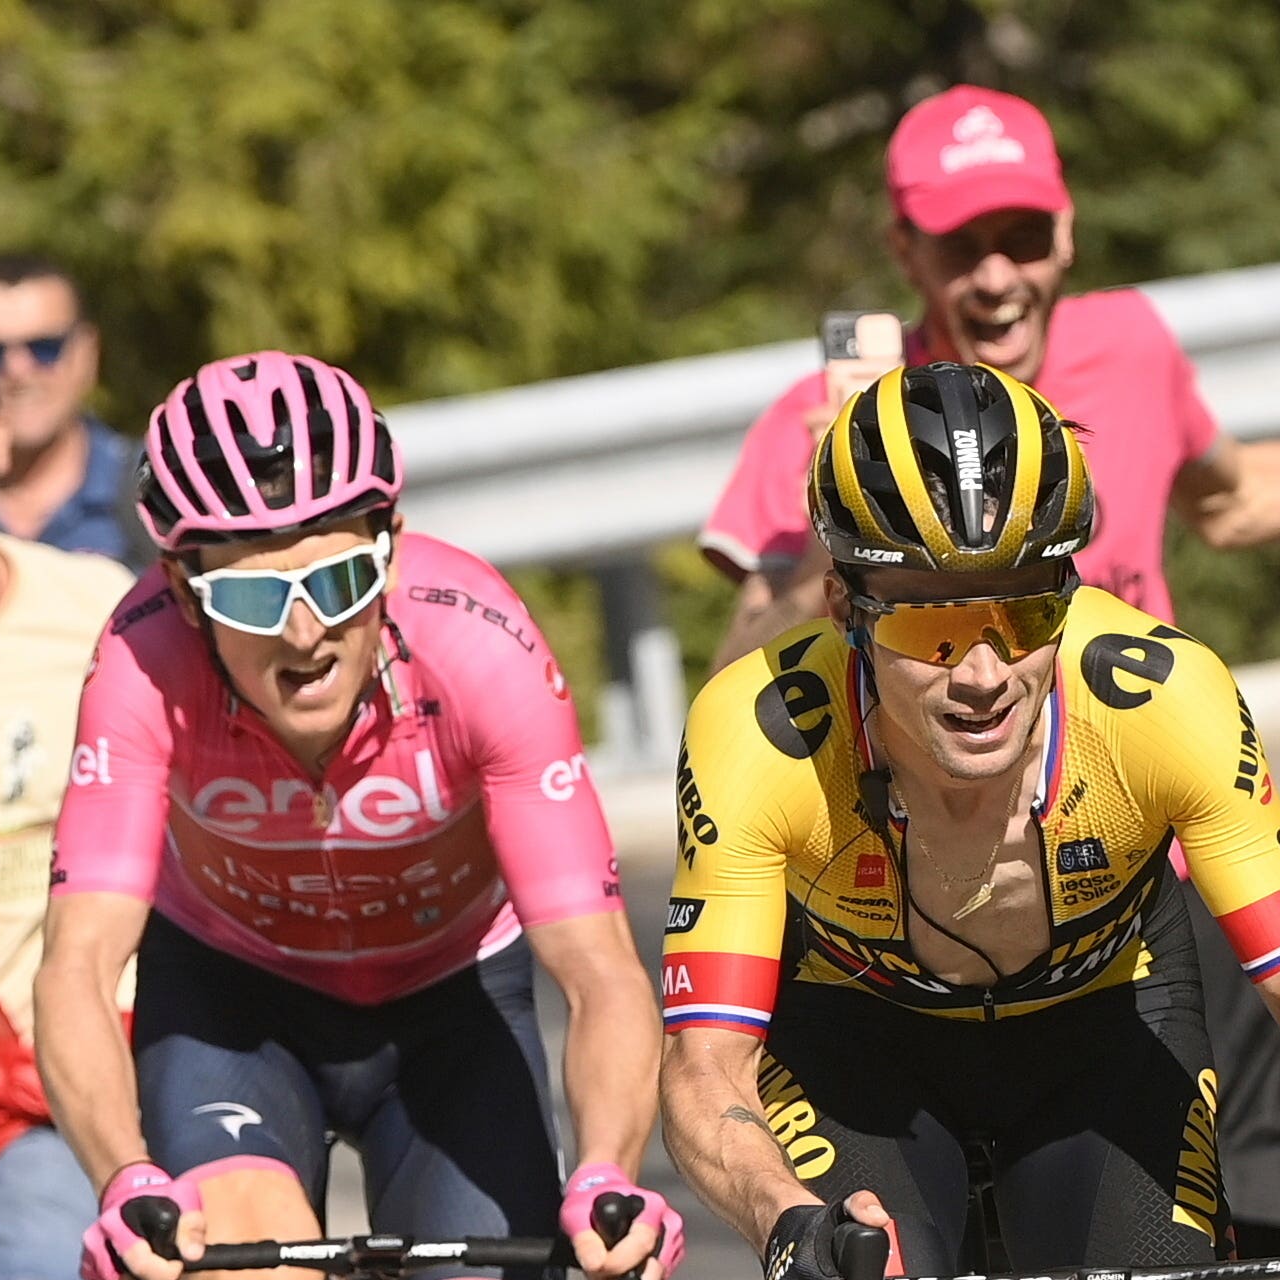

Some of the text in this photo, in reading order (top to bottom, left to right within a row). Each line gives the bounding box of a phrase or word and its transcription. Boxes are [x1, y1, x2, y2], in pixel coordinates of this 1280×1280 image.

[952, 428, 983, 491] PRIMOZ
[854, 546, 904, 563] LAZER
[191, 747, 451, 837] enel
[1172, 1067, 1218, 1248] JUMBO
